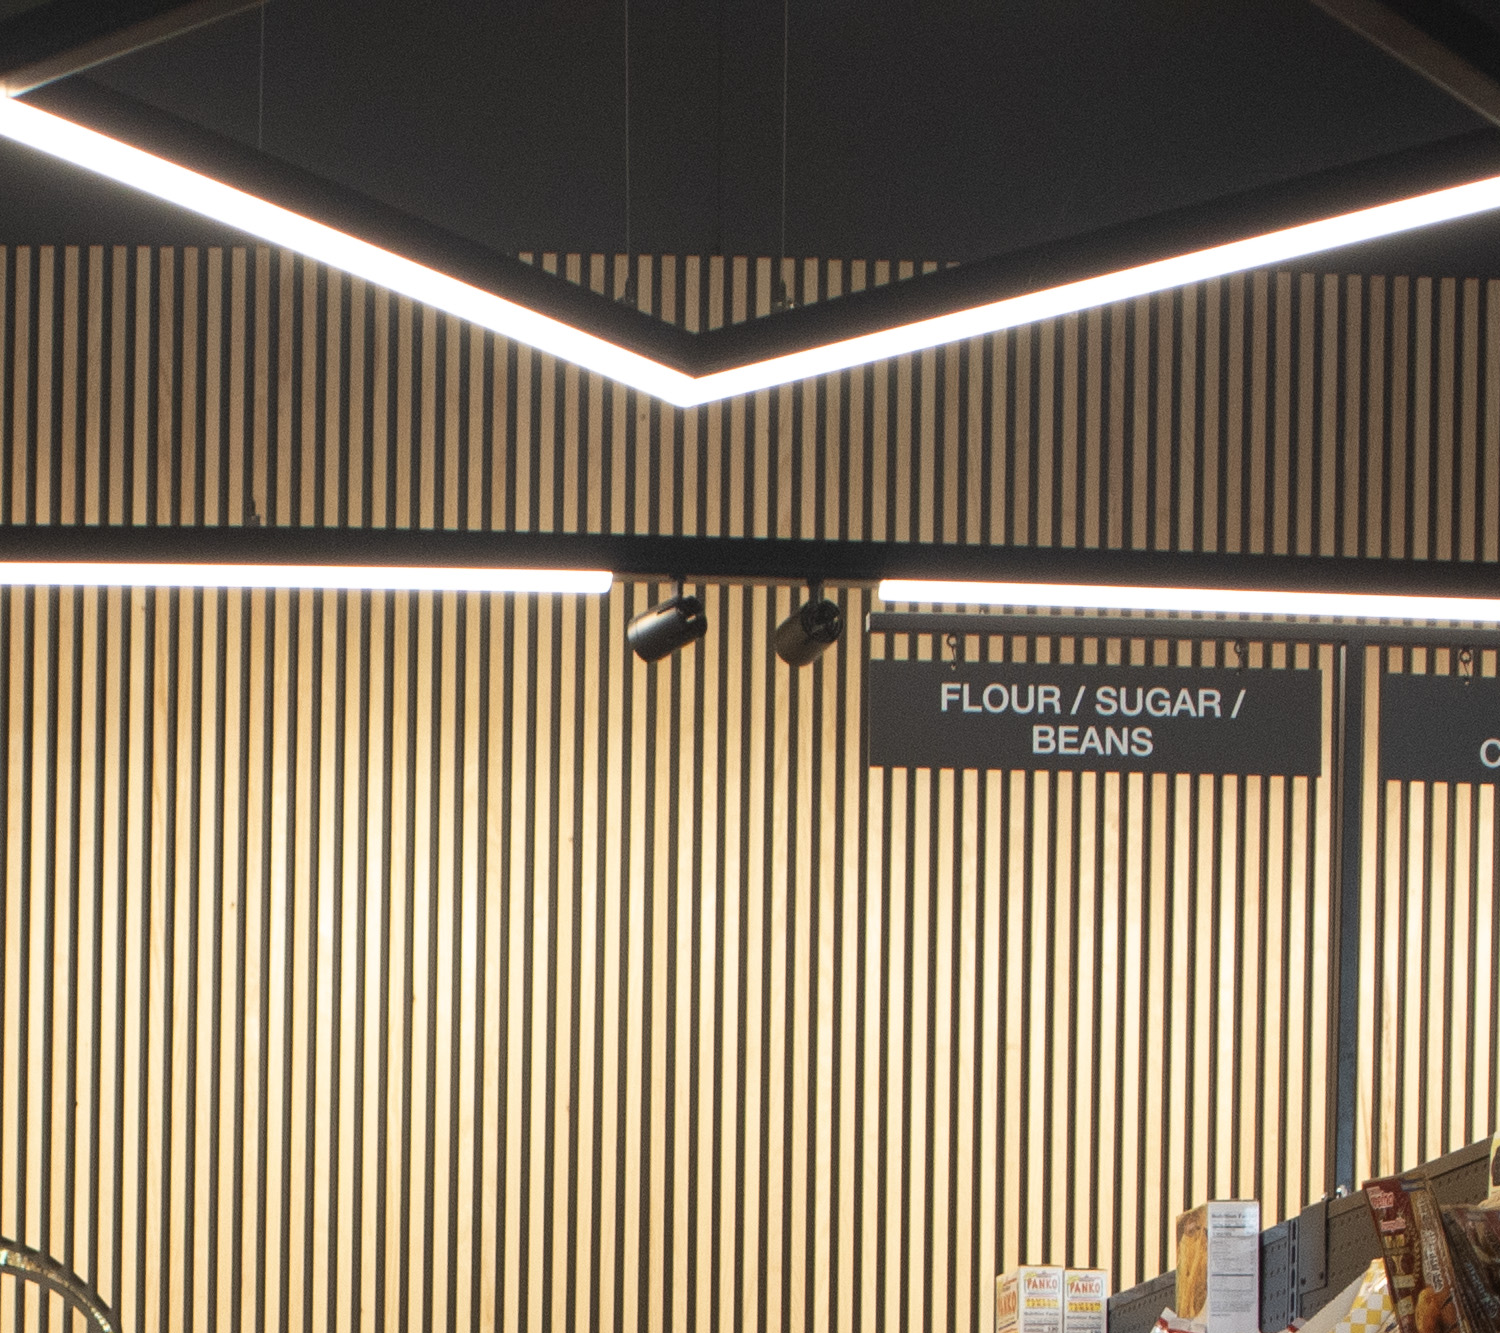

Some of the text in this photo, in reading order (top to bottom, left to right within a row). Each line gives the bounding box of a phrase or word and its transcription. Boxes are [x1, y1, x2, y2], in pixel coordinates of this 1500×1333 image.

[940, 682, 1247, 719] FLOUR / SUGAR /
[1032, 724, 1154, 757] BEANS
[1026, 1277, 1059, 1290] PANKO
[1069, 1281, 1101, 1294] PANKO
